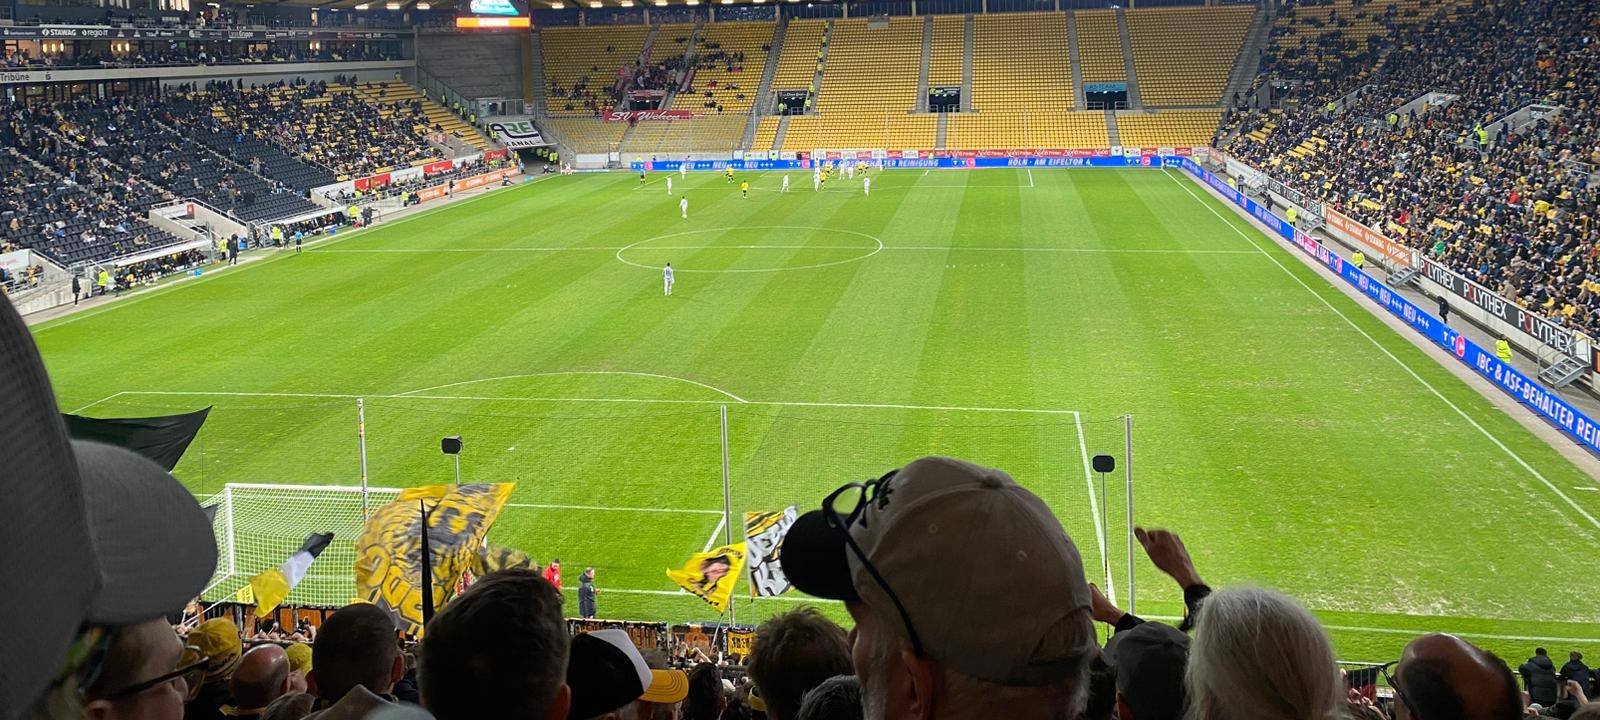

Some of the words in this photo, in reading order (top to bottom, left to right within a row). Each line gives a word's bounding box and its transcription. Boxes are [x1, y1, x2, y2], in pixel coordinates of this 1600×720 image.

[0, 73, 30, 81] Tribüne
[609, 112, 632, 121] SV
[1008, 158, 1028, 166] KÖLN
[1034, 158, 1046, 166] AM
[1048, 158, 1084, 166] EIFELTOR
[1358, 274, 1370, 291] NEU
[1380, 287, 1391, 305] NEU
[1403, 303, 1417, 321] NEU
[1463, 281, 1507, 319] POLYTHEX
[1476, 351, 1494, 373] IBC-
[1503, 370, 1575, 430] ASF-BEHÄLTER
